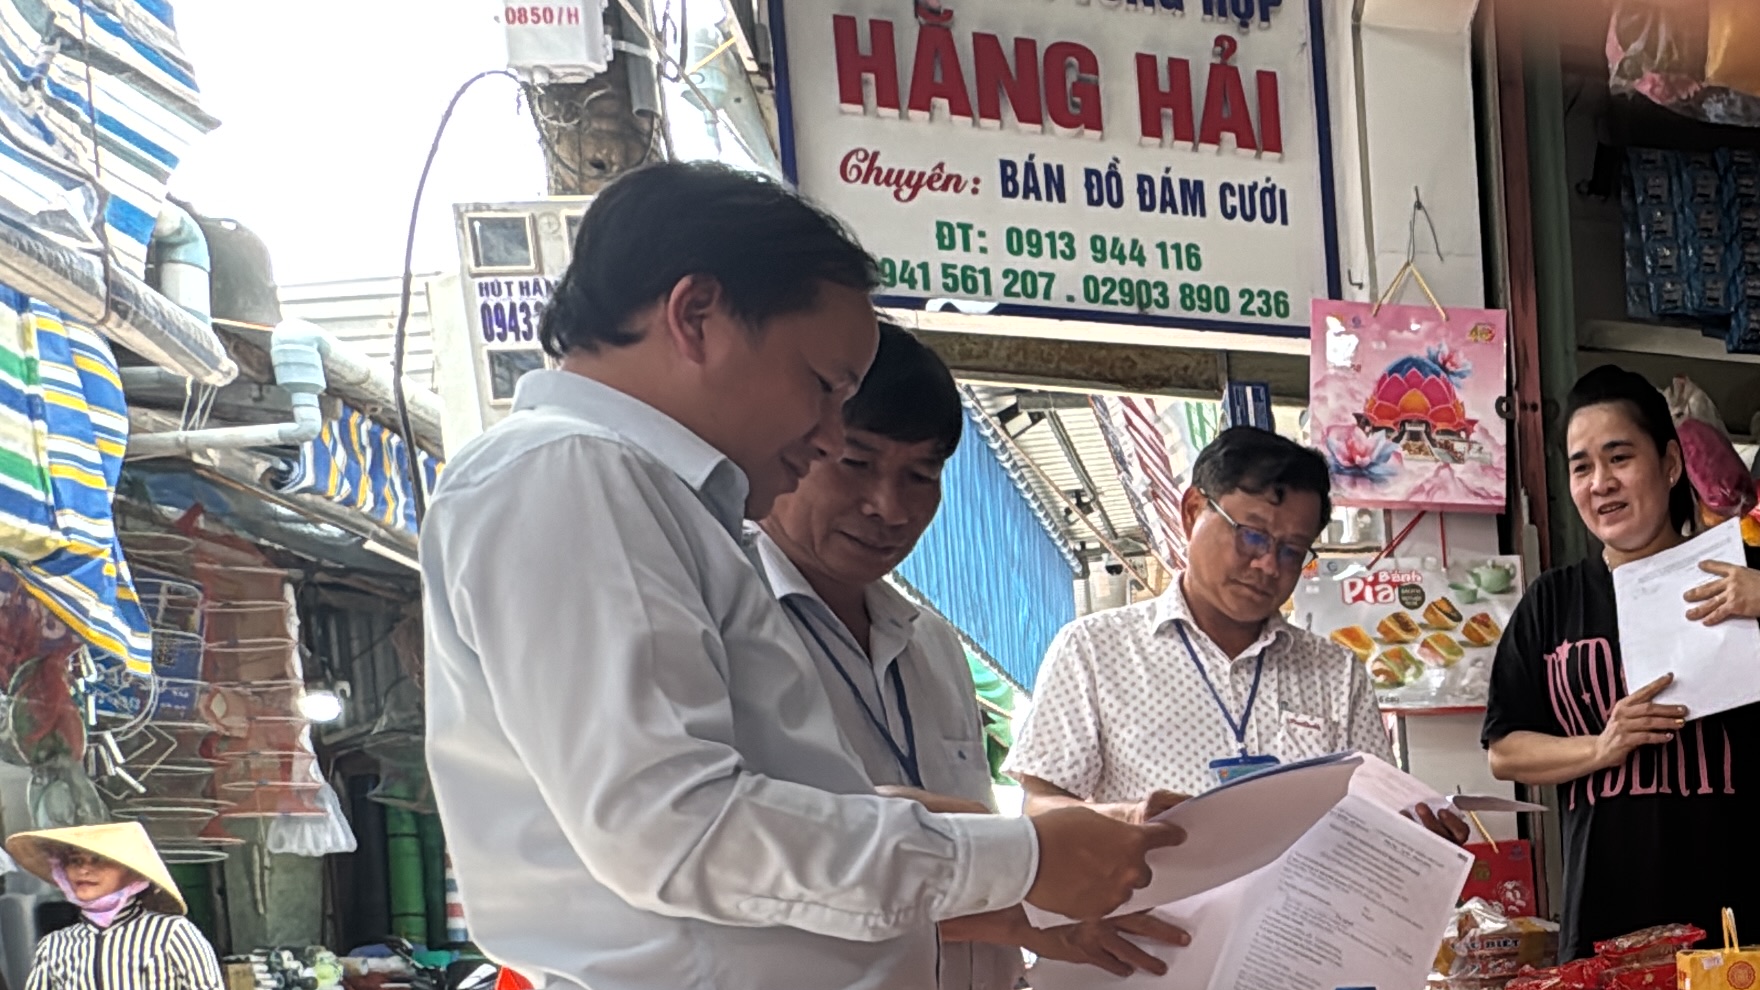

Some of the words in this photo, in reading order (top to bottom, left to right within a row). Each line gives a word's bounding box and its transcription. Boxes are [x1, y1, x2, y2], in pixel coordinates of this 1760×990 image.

[1135, 34, 1284, 155] HẢI
[839, 147, 981, 203] Chuyên:
[1000, 153, 1067, 203] BÁN
[1084, 156, 1124, 209] ĐỒ
[1137, 166, 1207, 217] ĐÁM
[1219, 176, 1289, 225] CƯỚI
[935, 221, 989, 254] ĐT:
[1006, 227, 1077, 261] 0913
[1090, 236, 1146, 268] 944
[1155, 241, 1202, 271] 116
[879, 258, 931, 290] 941
[942, 263, 992, 296] 561
[1003, 269, 1057, 301] 207
[1082, 275, 1171, 311] 02903
[1179, 282, 1231, 313] 890
[1239, 289, 1290, 319] 236
